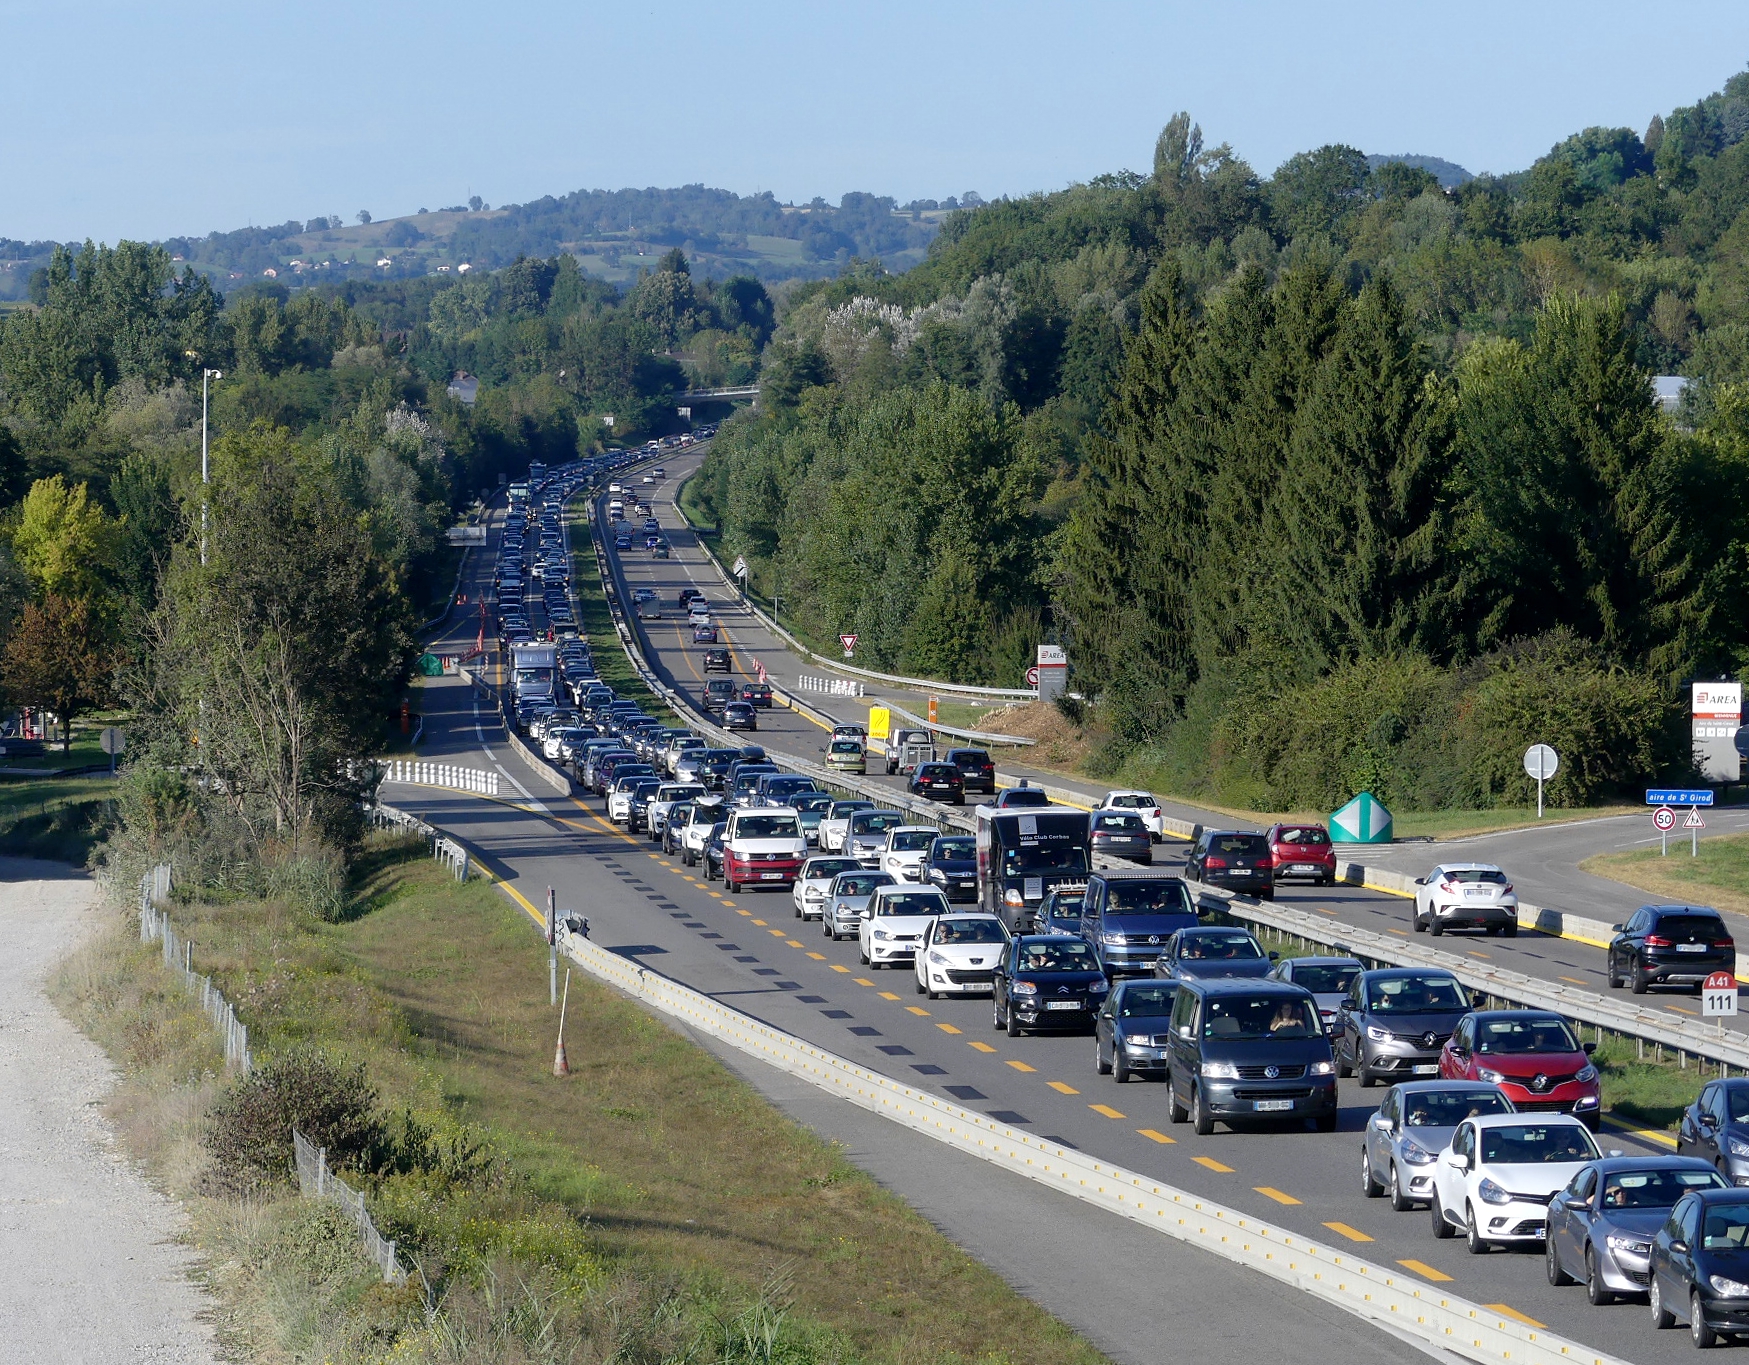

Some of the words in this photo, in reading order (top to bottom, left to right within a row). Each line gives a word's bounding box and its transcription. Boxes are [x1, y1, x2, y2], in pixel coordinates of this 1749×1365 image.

[1709, 695, 1737, 704] AREA
[1649, 793, 1665, 801] aire
[1690, 794, 1712, 802] Girod
[1657, 814, 1672, 825] 50
[1709, 995, 1731, 1010] 111
